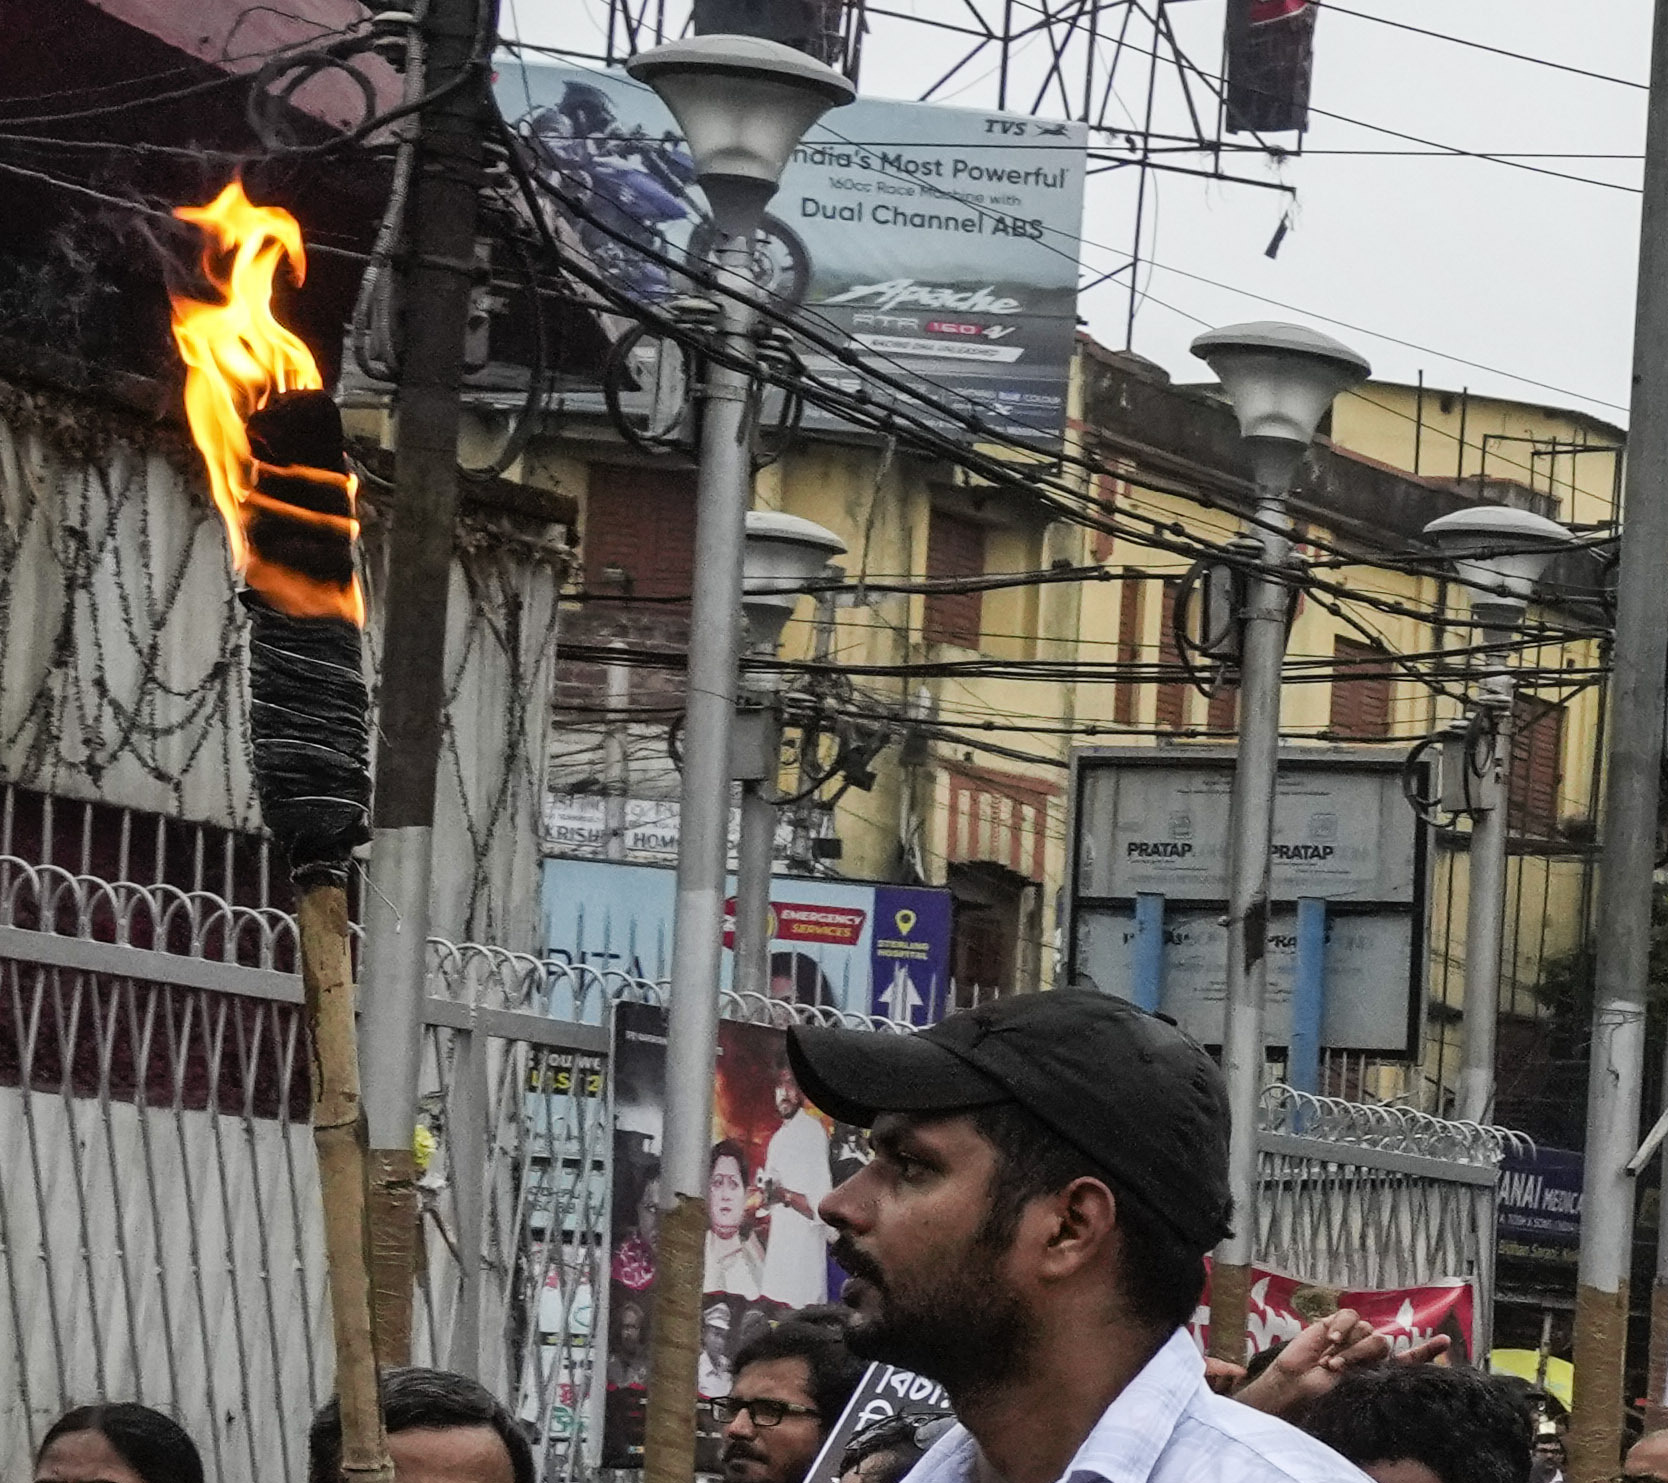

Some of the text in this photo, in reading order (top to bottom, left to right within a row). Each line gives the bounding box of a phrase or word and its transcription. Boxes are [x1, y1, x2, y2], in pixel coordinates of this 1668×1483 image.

[984, 118, 1027, 136] TVS
[792, 148, 1066, 189] ndia's Most Powerful
[801, 197, 1045, 240] Dual Channel ABS
[824, 278, 1024, 314] Apache
[1126, 842, 1193, 858] PRATAP
[781, 909, 864, 925] EMERGENCY
[792, 924, 852, 937] SERVICES
